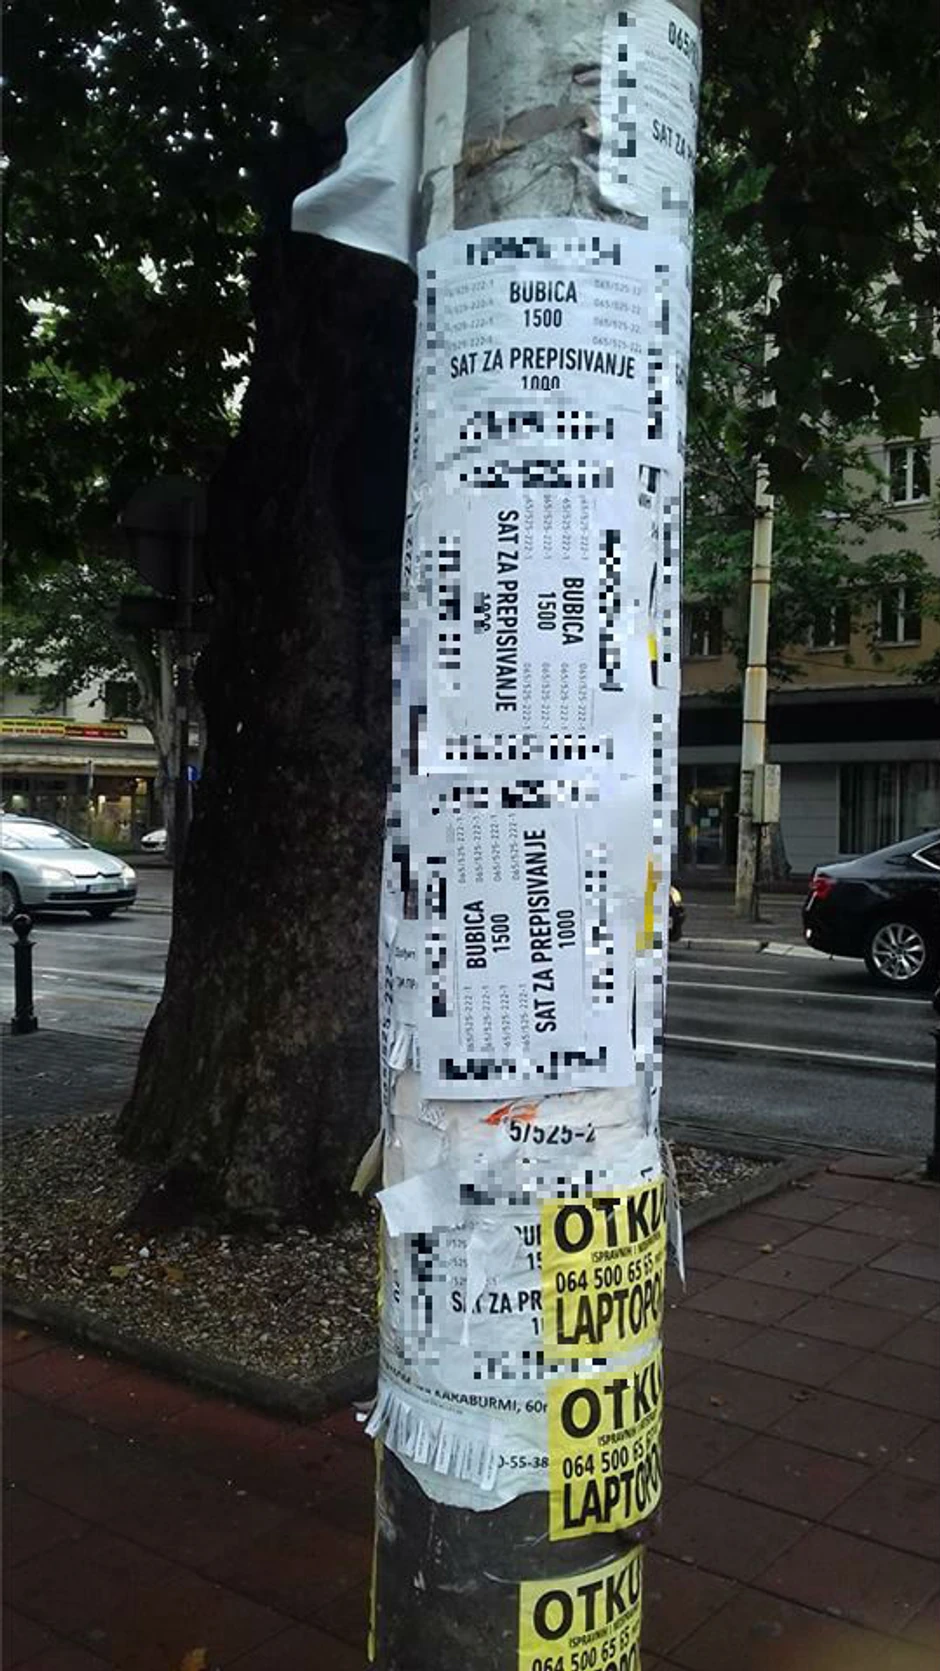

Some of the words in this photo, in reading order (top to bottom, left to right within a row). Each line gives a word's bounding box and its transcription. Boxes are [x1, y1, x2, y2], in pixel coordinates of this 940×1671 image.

[653, 118, 672, 149] SAT
[509, 280, 577, 303] BUBICA
[523, 308, 562, 328] 1500
[450, 352, 478, 379] SAT
[482, 349, 503, 372] ZA
[509, 347, 635, 380] PREPISIVANJE
[497, 509, 519, 545] SAT
[497, 552, 519, 575] ZA
[538, 591, 556, 631] 1500
[562, 577, 585, 646] BUBICA
[495, 580, 519, 712] PREPISIVANJE
[524, 829, 551, 963] PREPISIVANJE
[463, 900, 487, 969] BUBICA
[491, 913, 511, 953] 1500
[557, 909, 576, 950] 1000
[533, 969, 555, 995] ZA
[535, 996, 557, 1034] SAT
[556, 1269, 588, 1294] 064
[594, 1264, 622, 1289] 500
[628, 1258, 641, 1282] 65
[488, 1291, 512, 1314] ZA
[563, 1453, 595, 1479] 064
[601, 1446, 629, 1474] 500
[533, 1556, 640, 1641] OTKU
[571, 1646, 597, 1671] 500
[601, 1636, 616, 1662] 65
